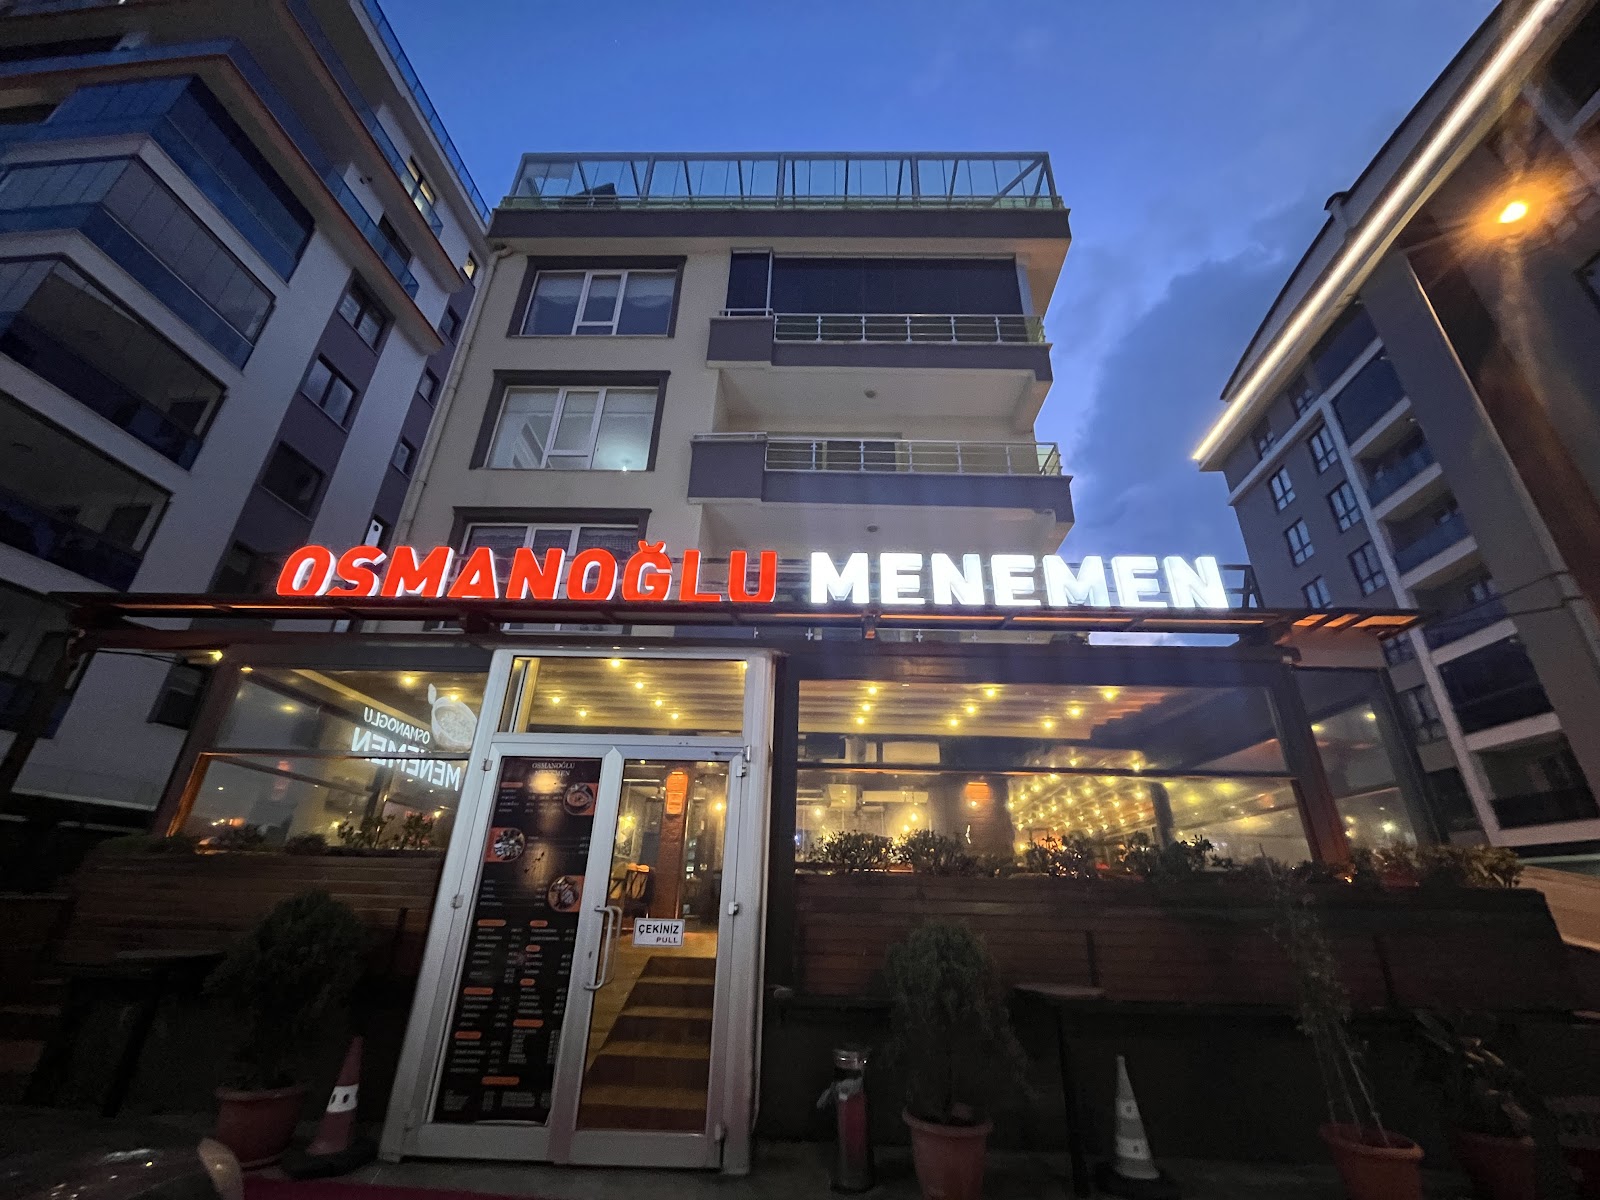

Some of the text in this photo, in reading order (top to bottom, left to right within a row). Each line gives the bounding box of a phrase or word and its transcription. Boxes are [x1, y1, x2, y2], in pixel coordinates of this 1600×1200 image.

[276, 540, 1230, 609] OSMANOĞLU MENEMEN
[638, 923, 680, 936] ÇEKİNİZ
